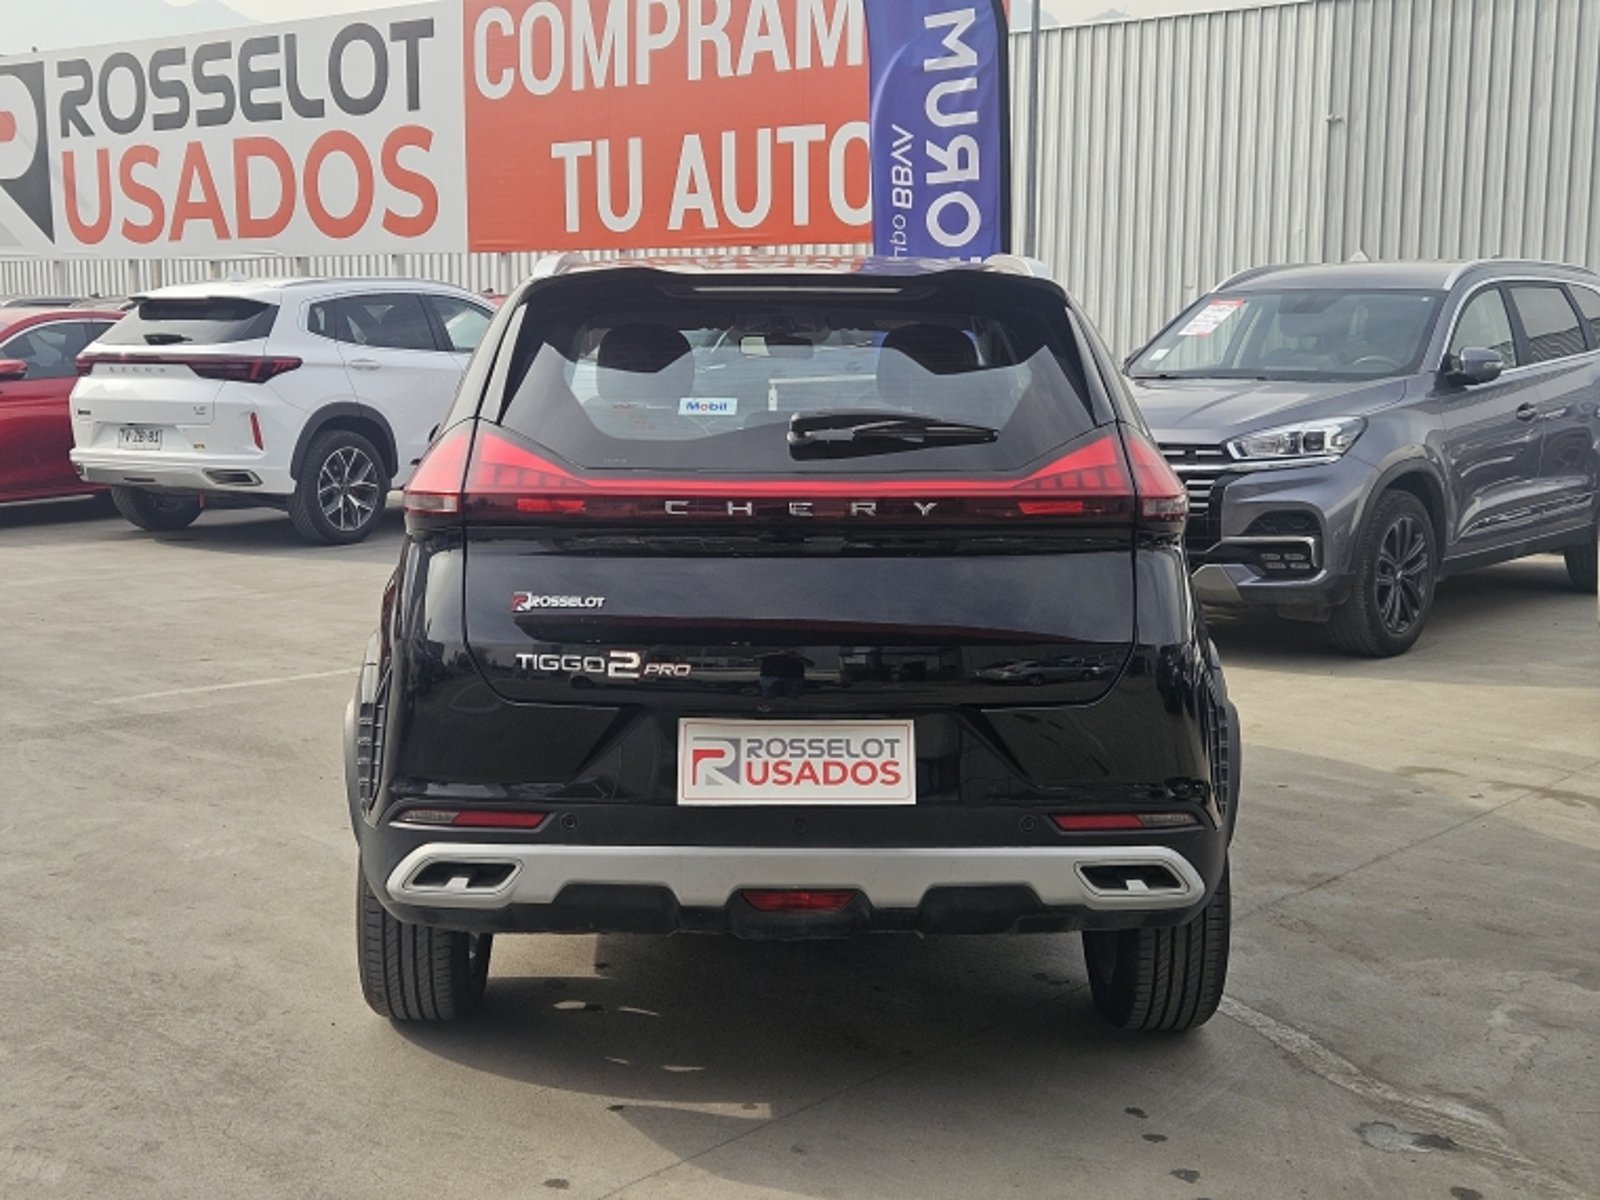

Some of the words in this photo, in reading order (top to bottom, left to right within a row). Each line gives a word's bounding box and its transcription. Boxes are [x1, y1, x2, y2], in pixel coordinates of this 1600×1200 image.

[474, 0, 864, 99] COMPRAM
[57, 18, 435, 138] ROSSELOT
[62, 125, 439, 245] USADOS
[550, 137, 643, 232] TU
[666, 121, 872, 229] AUTO
[686, 402, 728, 412] Mobil
[664, 500, 938, 517] CHERY
[530, 595, 605, 608] ROSSELOT
[643, 664, 692, 677] PRO
[746, 738, 900, 759] ROSSELOT
[745, 760, 902, 786] USADOS
